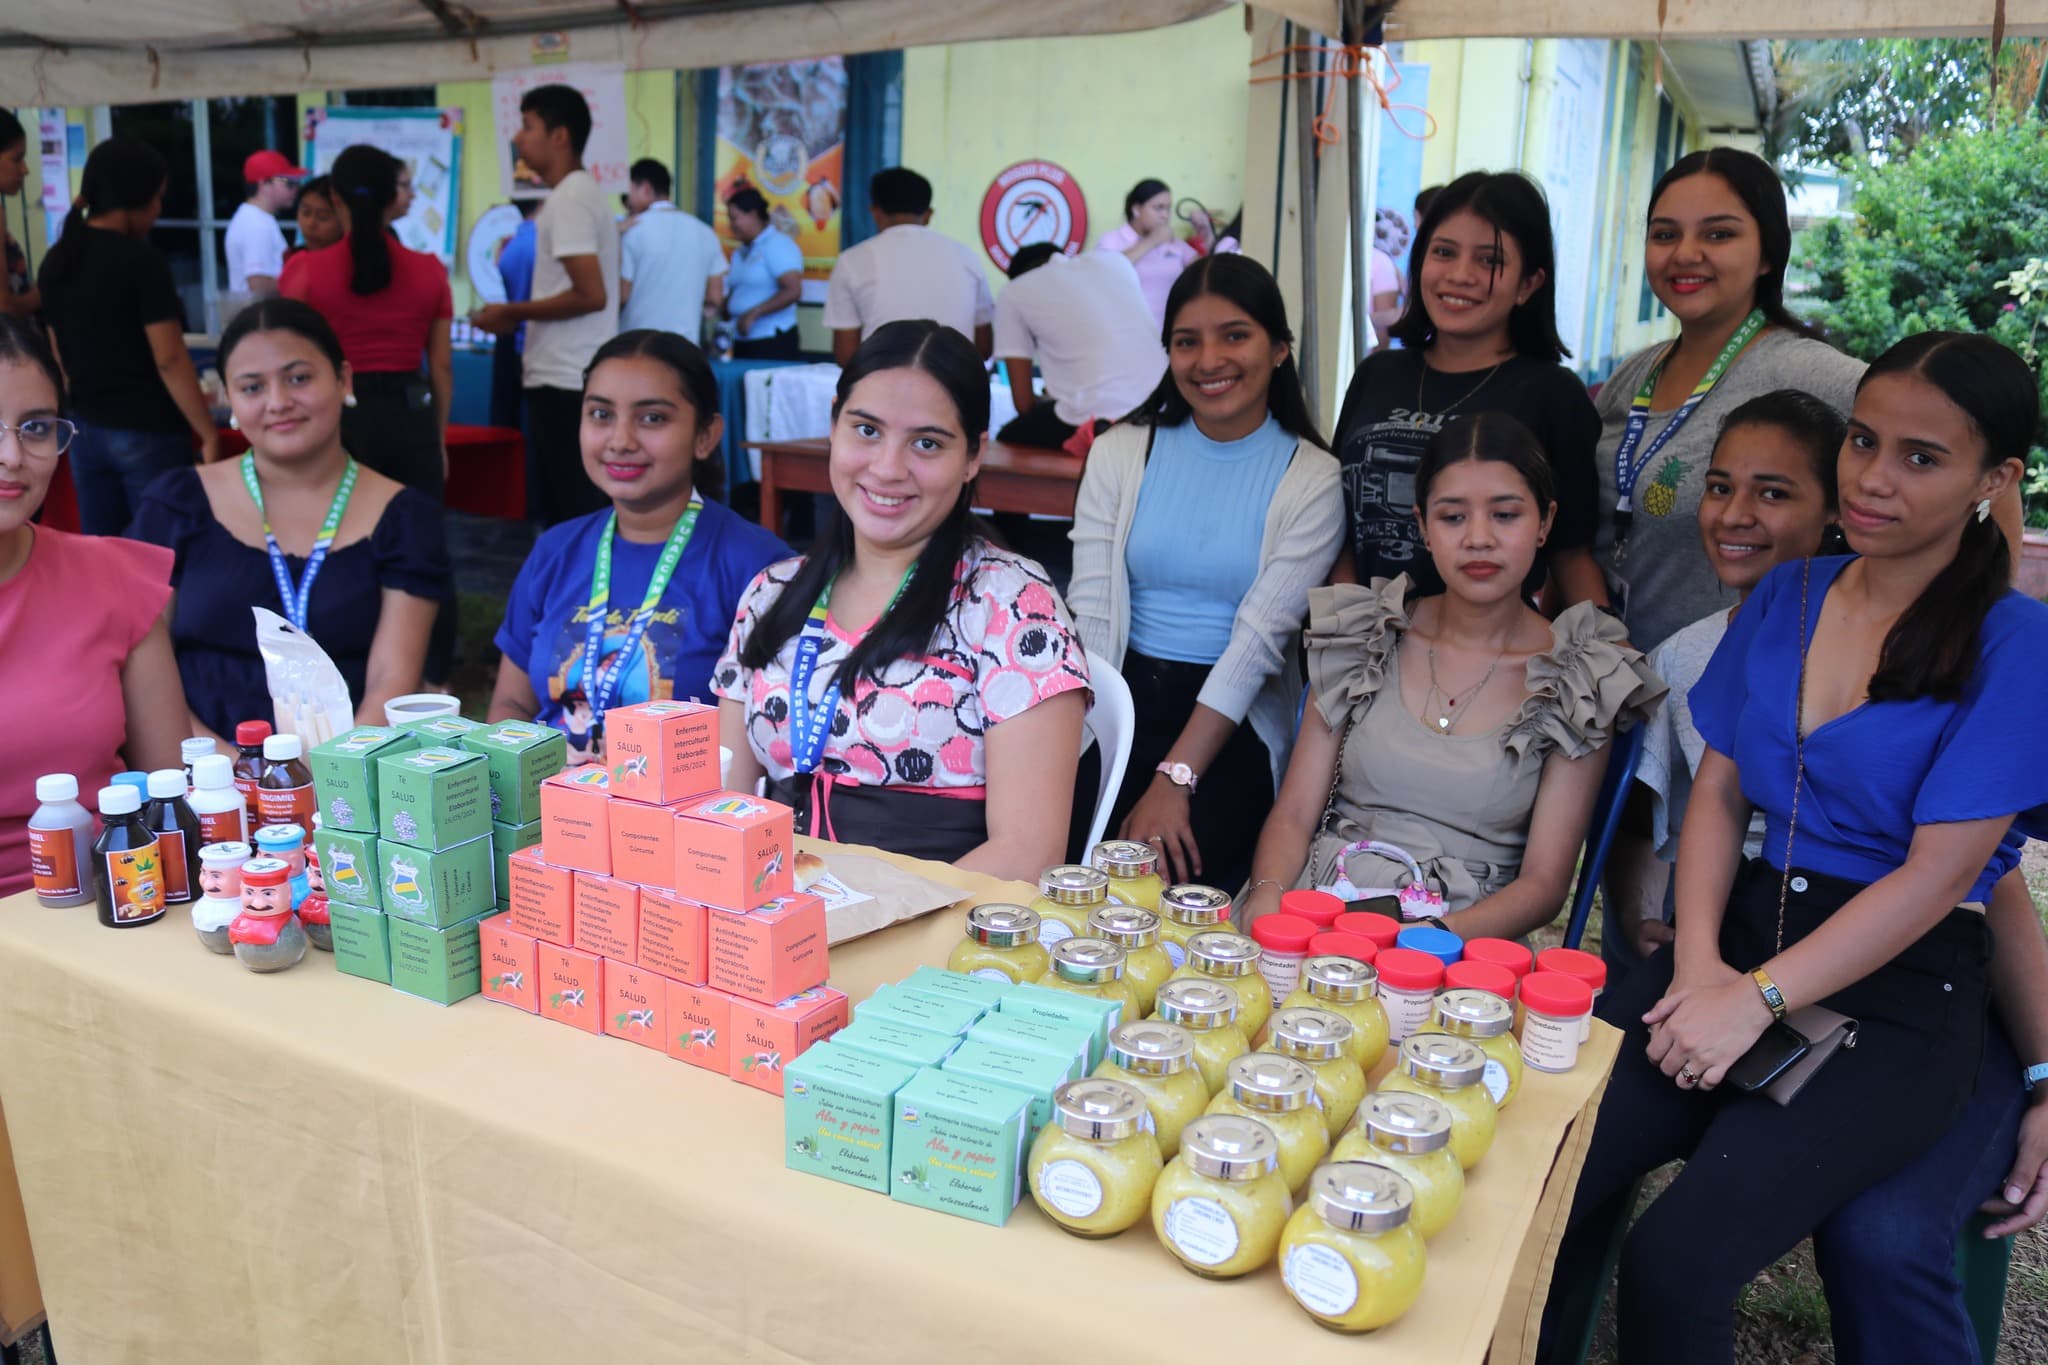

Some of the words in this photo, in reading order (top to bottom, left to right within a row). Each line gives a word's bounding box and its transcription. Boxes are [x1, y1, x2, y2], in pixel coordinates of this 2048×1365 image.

[801, 686, 838, 767] FERMERIA
[616, 741, 642, 753] SALUD
[674, 734, 711, 749] Intercultural
[326, 778, 349, 789] SALUD
[391, 790, 415, 803] SALUD
[757, 843, 779, 860] SALUD
[492, 953, 517, 967] SALUD
[553, 972, 579, 987] SALUD
[619, 989, 647, 1005] SALUD
[682, 1011, 711, 1026] SALUD
[746, 1033, 775, 1050] SALUD
[815, 1109, 837, 1123] Aloe
[925, 1136, 950, 1153] Aloe
[839, 1147, 870, 1163] Elaborado
[949, 1177, 983, 1193] Elaborado
